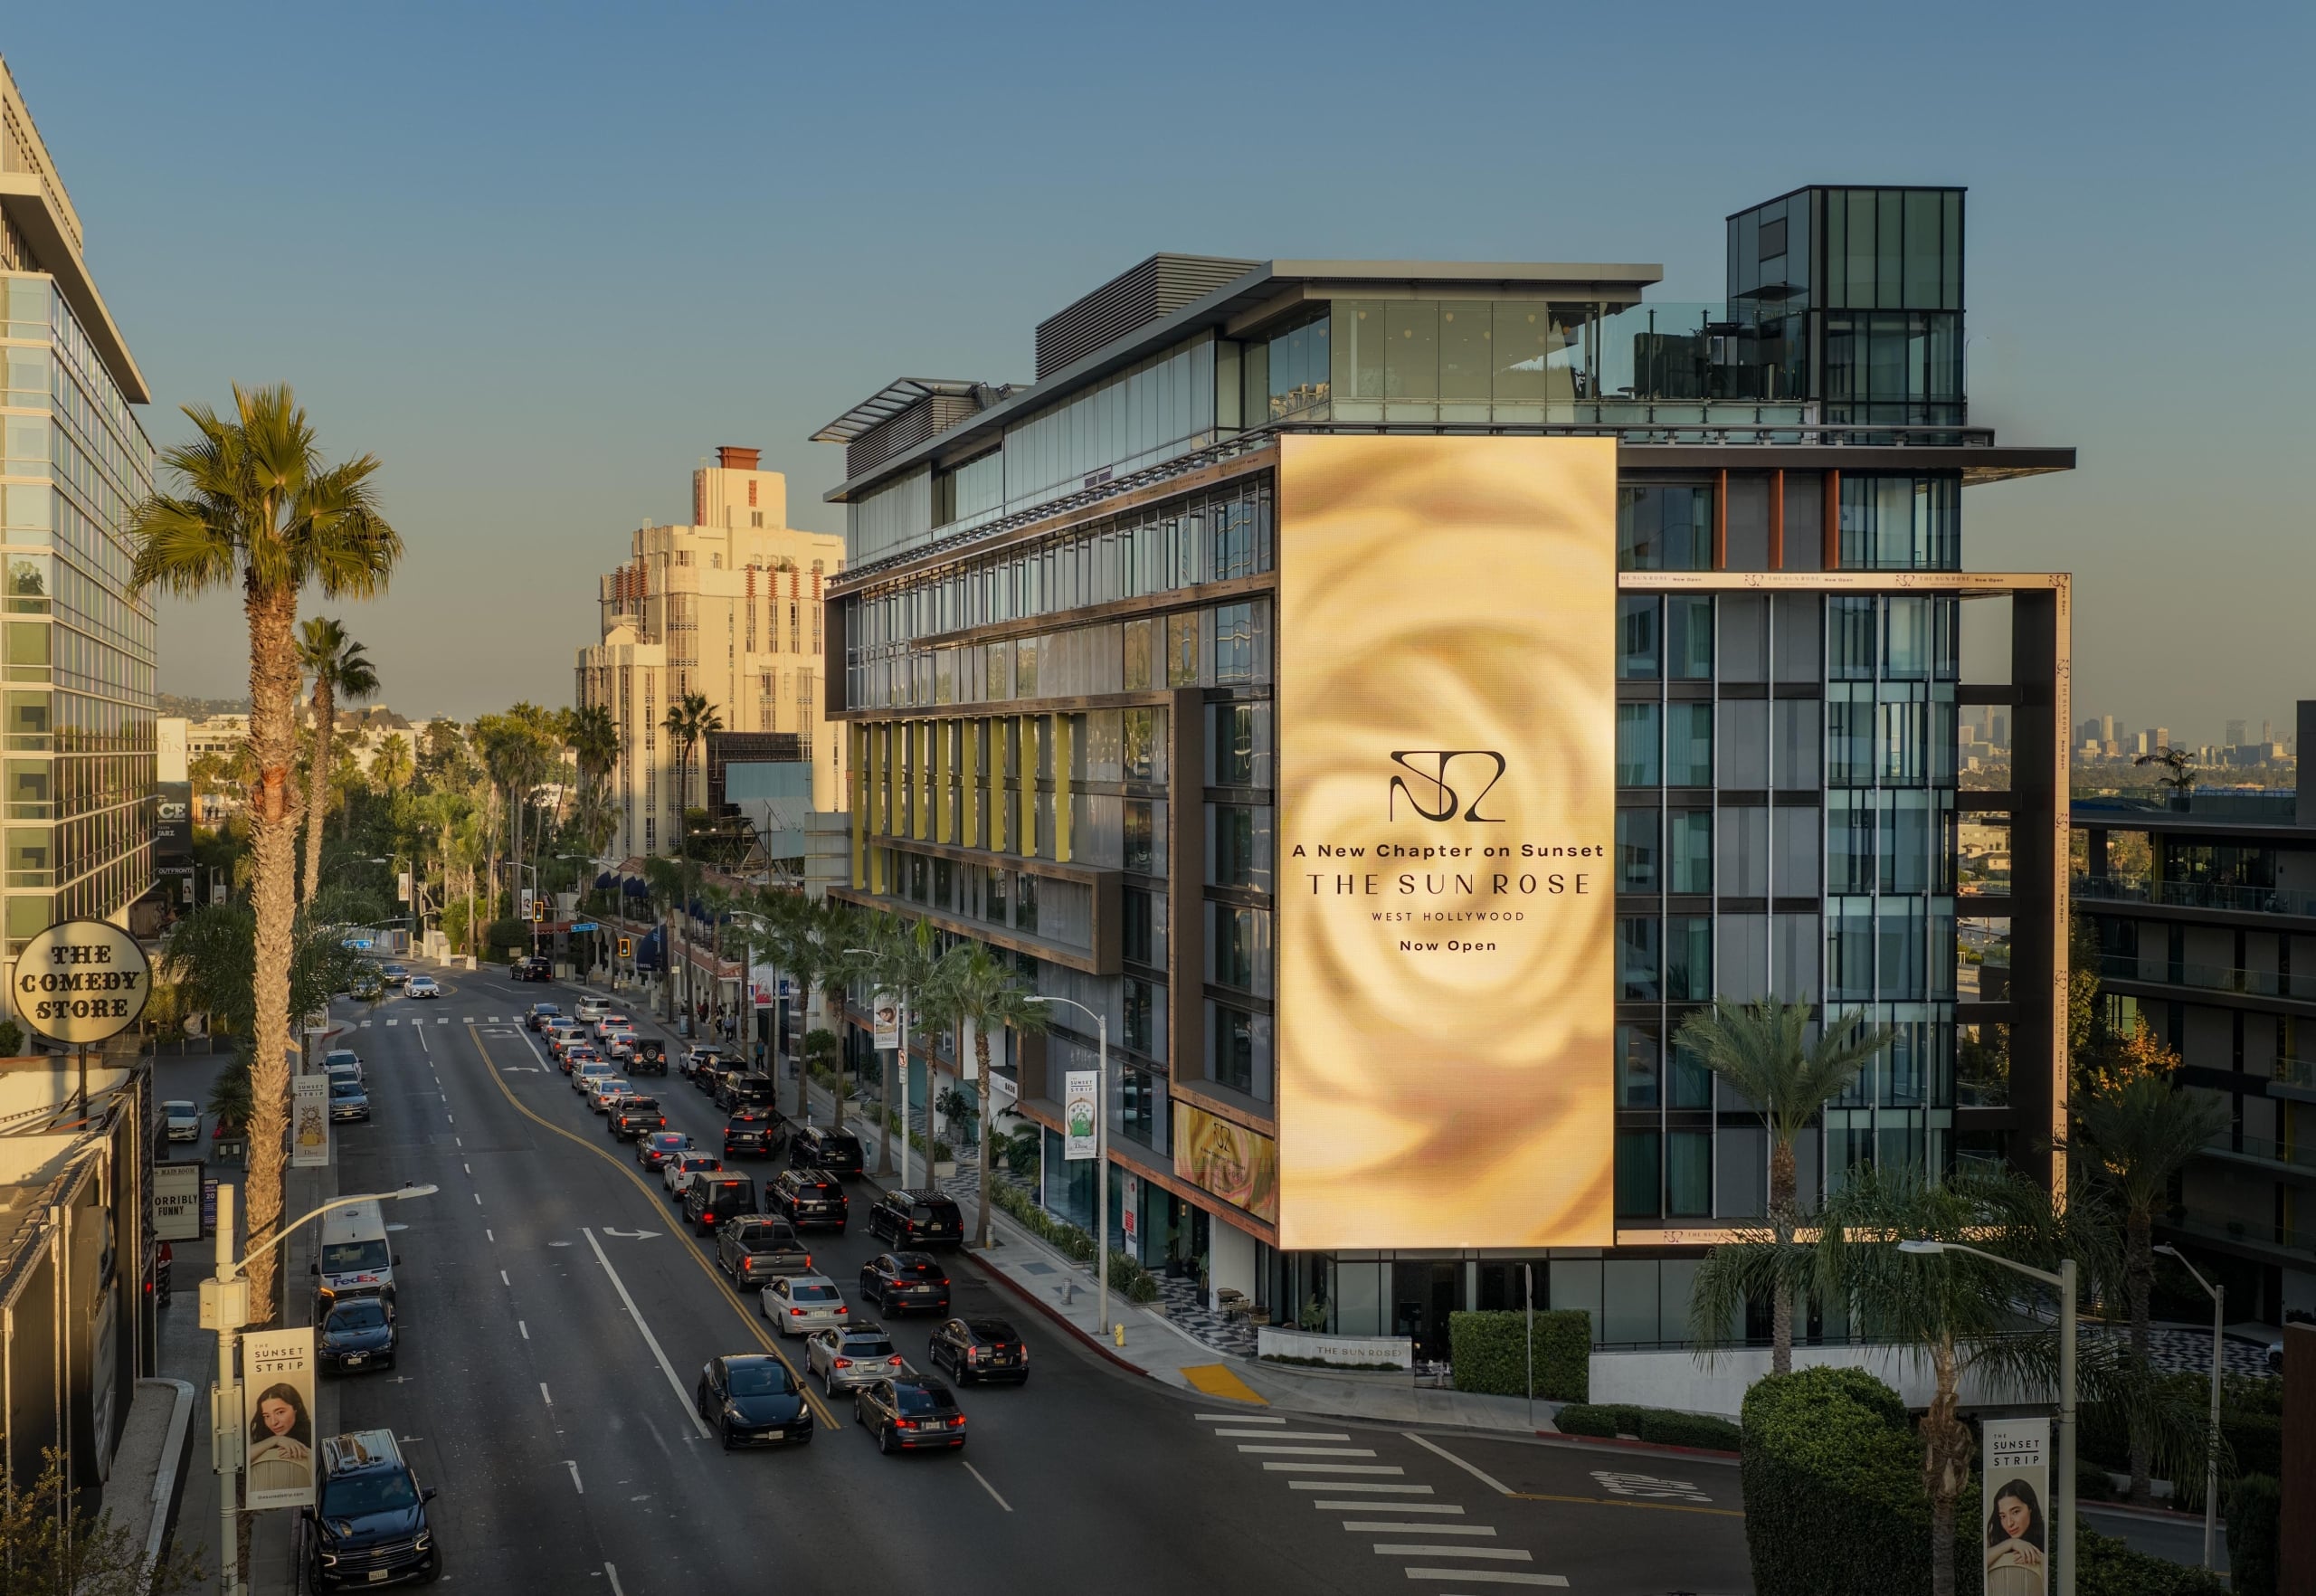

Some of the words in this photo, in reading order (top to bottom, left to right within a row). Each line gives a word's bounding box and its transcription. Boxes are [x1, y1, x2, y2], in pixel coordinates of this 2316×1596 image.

[1292, 844, 1305, 857] A
[1318, 844, 1365, 857] New
[1376, 844, 1473, 860] Chapter
[1484, 847, 1510, 857] on
[1521, 844, 1604, 857] Sunset
[1306, 874, 1379, 895] THE
[1399, 874, 1473, 895] SUN
[1494, 874, 1590, 895] ROSE
[1372, 912, 1412, 921] WEST
[1423, 912, 1524, 921] HOLLYWOOD
[1400, 940, 1438, 951] Now
[1448, 940, 1496, 953] Open
[52, 945, 111, 964] THE
[20, 972, 140, 993] COMEDY
[36, 999, 128, 1019] STORE
[155, 1194, 197, 1205] ORRIBLY
[158, 1206, 184, 1216] FUNNY
[334, 1275, 378, 1286] FedEx
[255, 1348, 303, 1357] SUNSET
[1317, 1346, 1338, 1354] THE
[1342, 1348, 1364, 1356] SUN
[1368, 1349, 1397, 1357] ROSE
[256, 1362, 303, 1372] STRIP
[1994, 1440, 2039, 1449] SUNSET
[1994, 1456, 2039, 1467] STRIP
